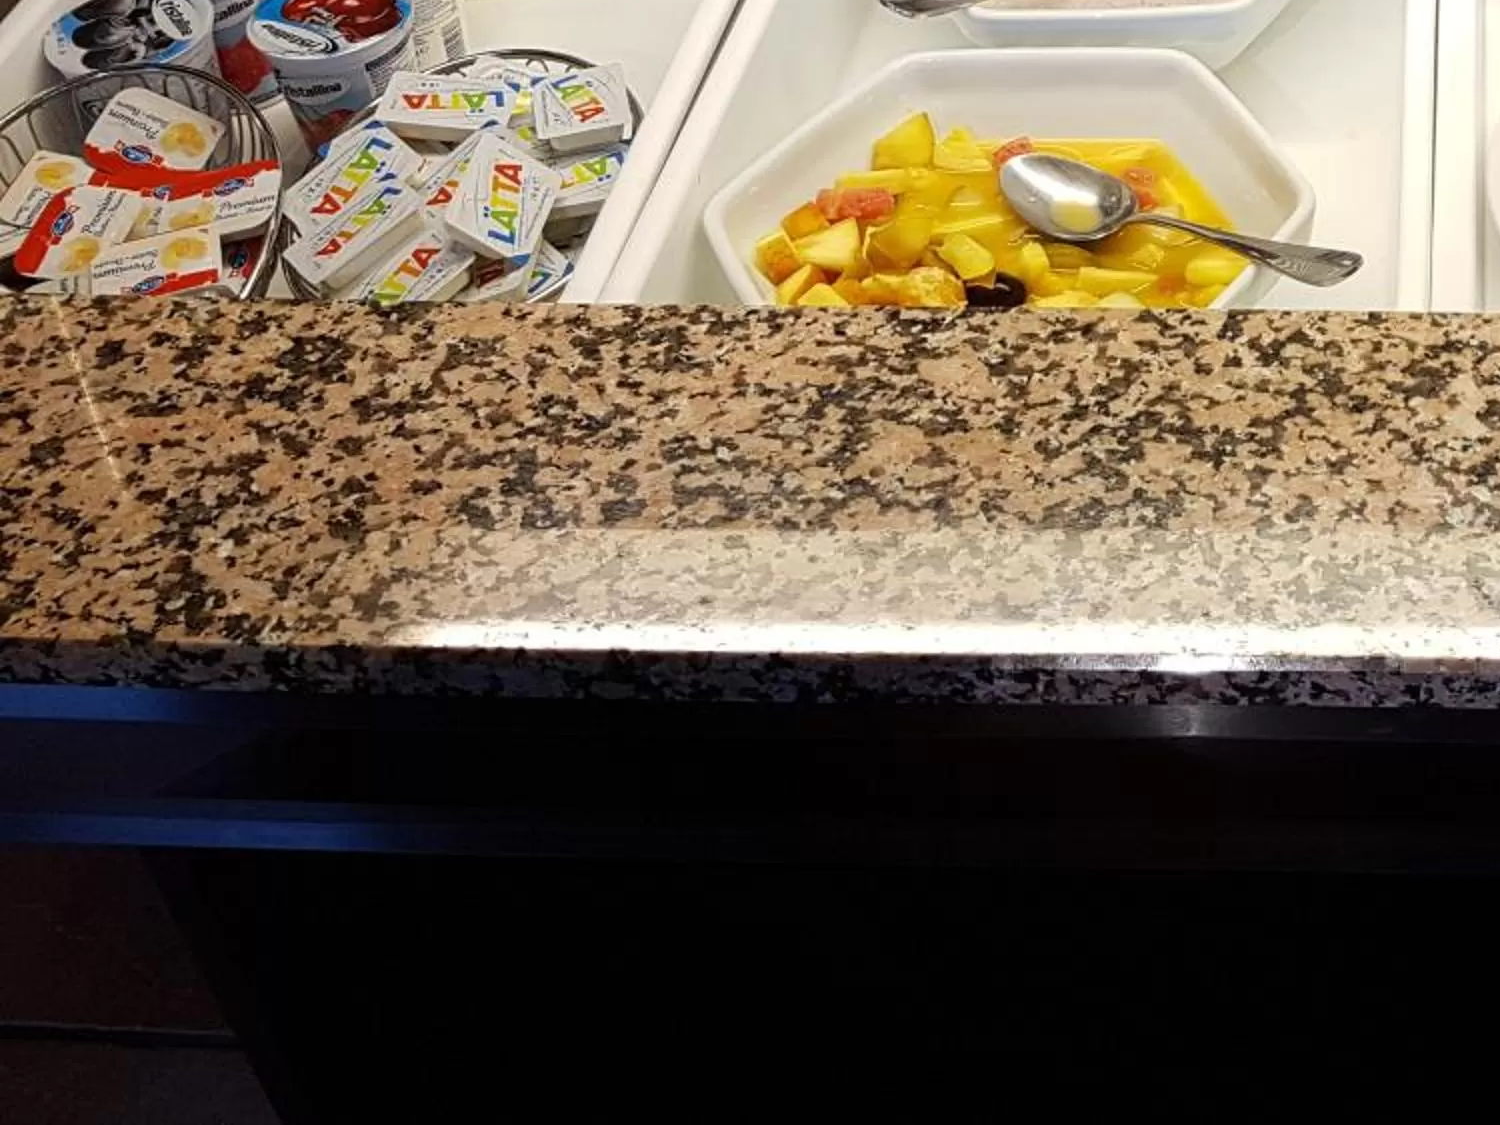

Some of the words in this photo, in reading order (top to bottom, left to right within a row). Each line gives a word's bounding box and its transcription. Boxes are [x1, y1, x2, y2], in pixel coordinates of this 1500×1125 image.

[402, 90, 505, 115] LÄTTA
[309, 136, 393, 215] LÄTTA
[484, 163, 523, 245] LÄTTA
[313, 186, 402, 257] LÄTTA
